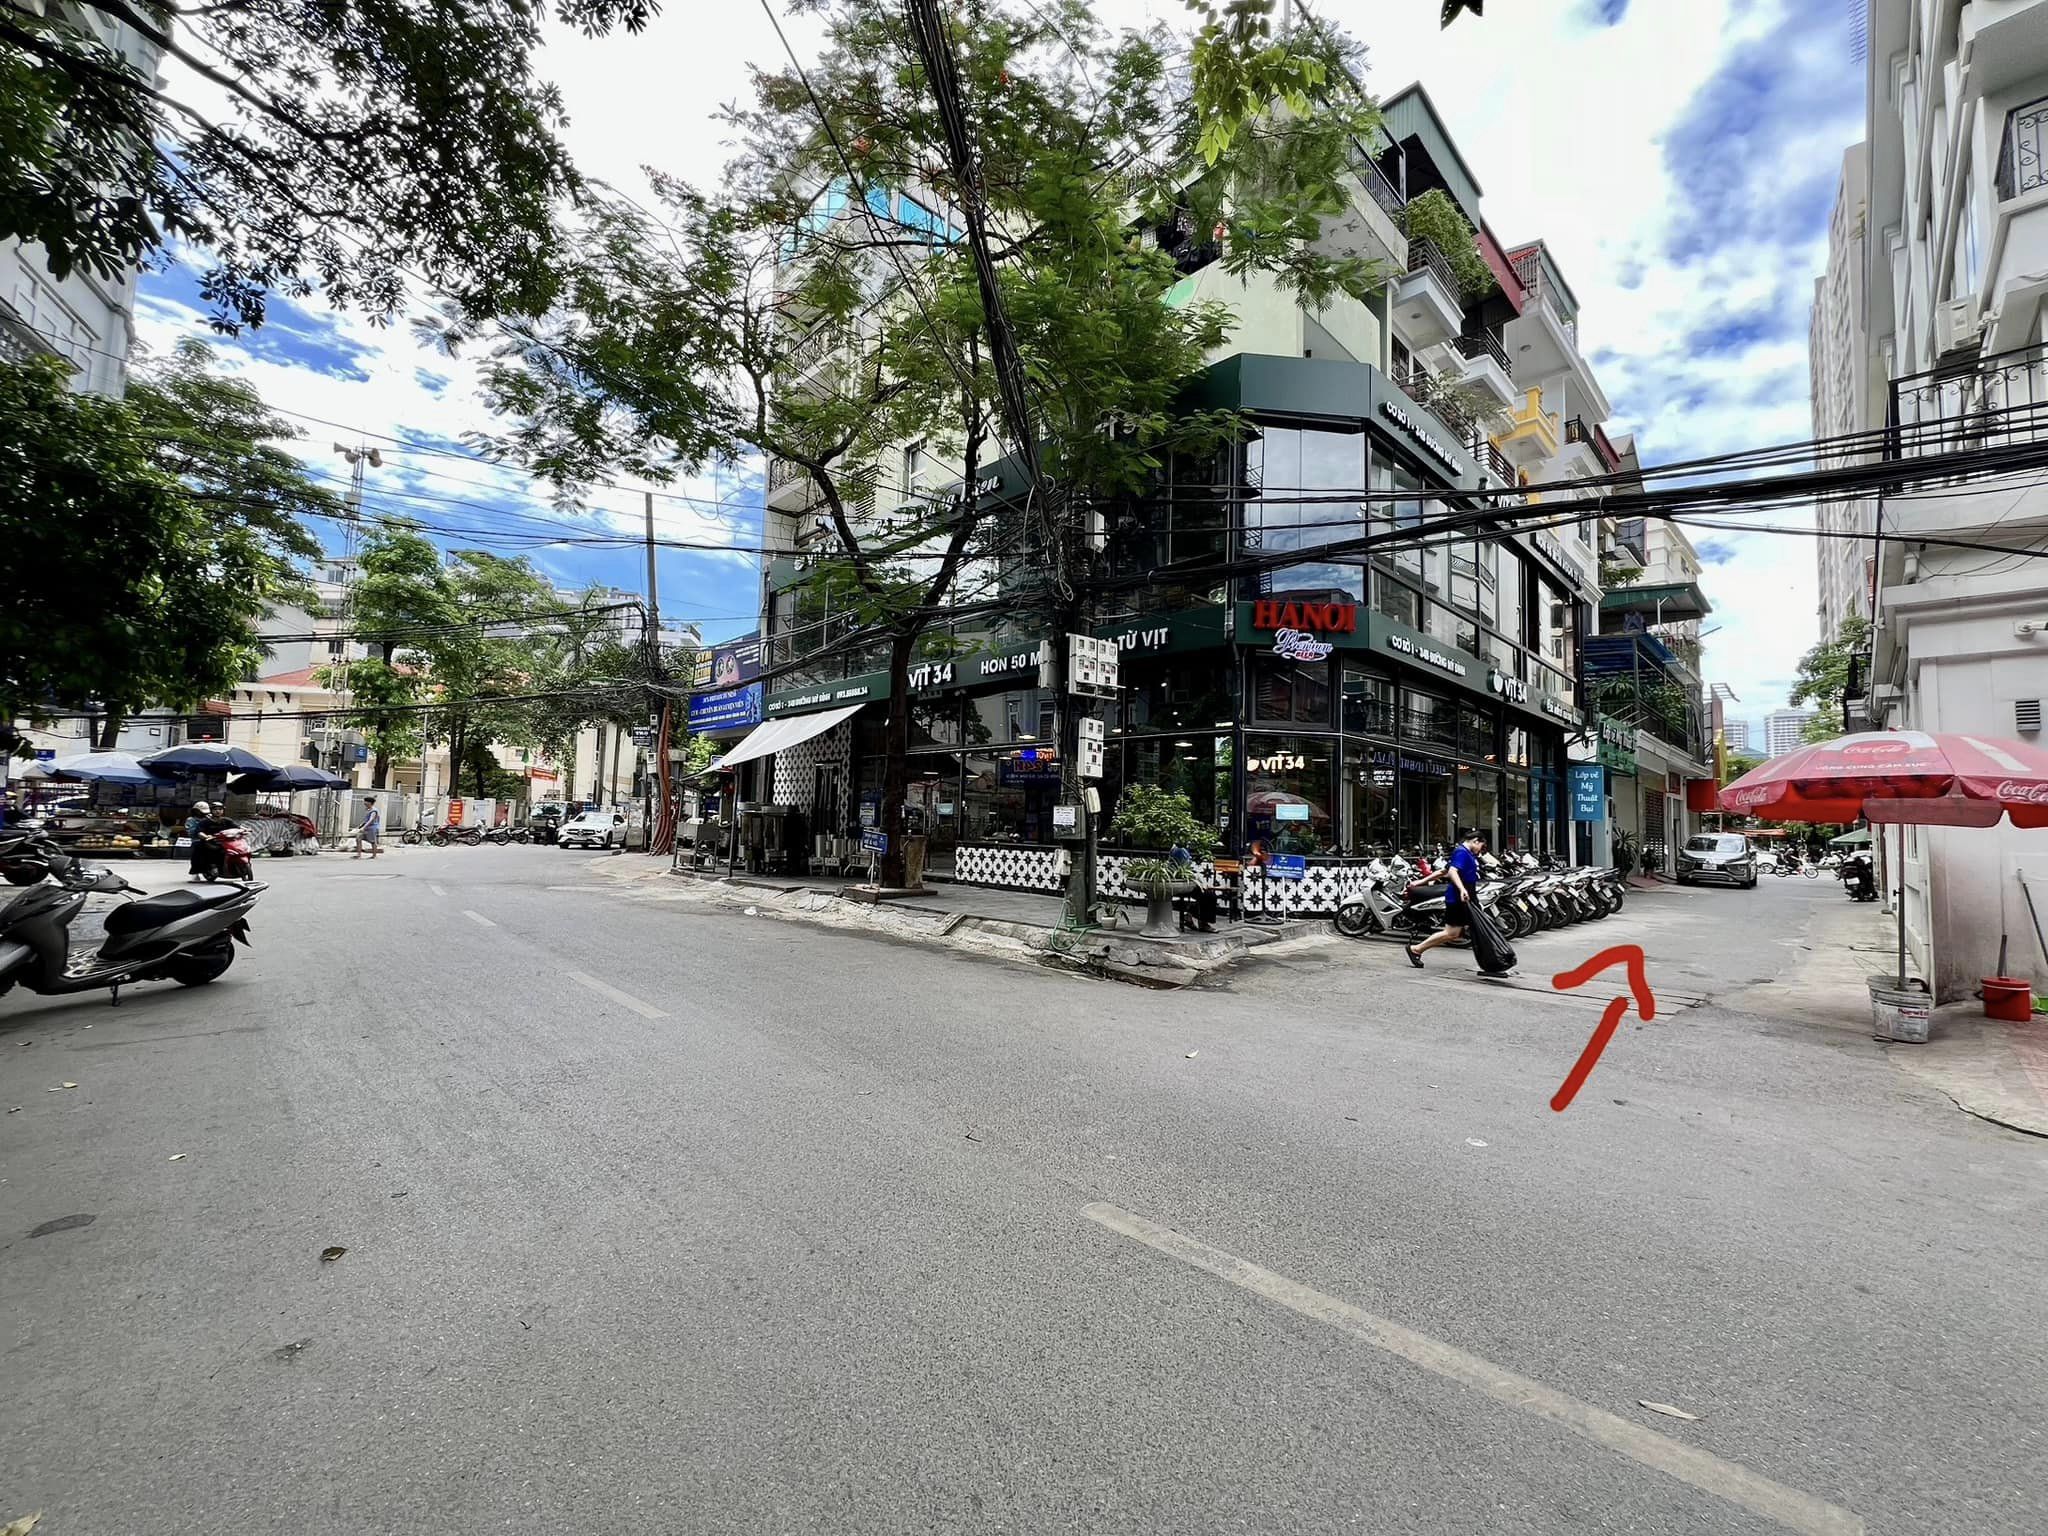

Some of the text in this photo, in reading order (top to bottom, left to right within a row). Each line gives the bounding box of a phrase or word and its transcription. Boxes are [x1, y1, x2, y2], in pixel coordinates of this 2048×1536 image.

[1254, 599, 1357, 632] HANOI
[1117, 627, 1169, 651] TỪ VỊT
[1273, 627, 1334, 654] Premium
[980, 653, 1026, 675] HƠN 50
[1735, 785, 1768, 805] Coca-Cola
